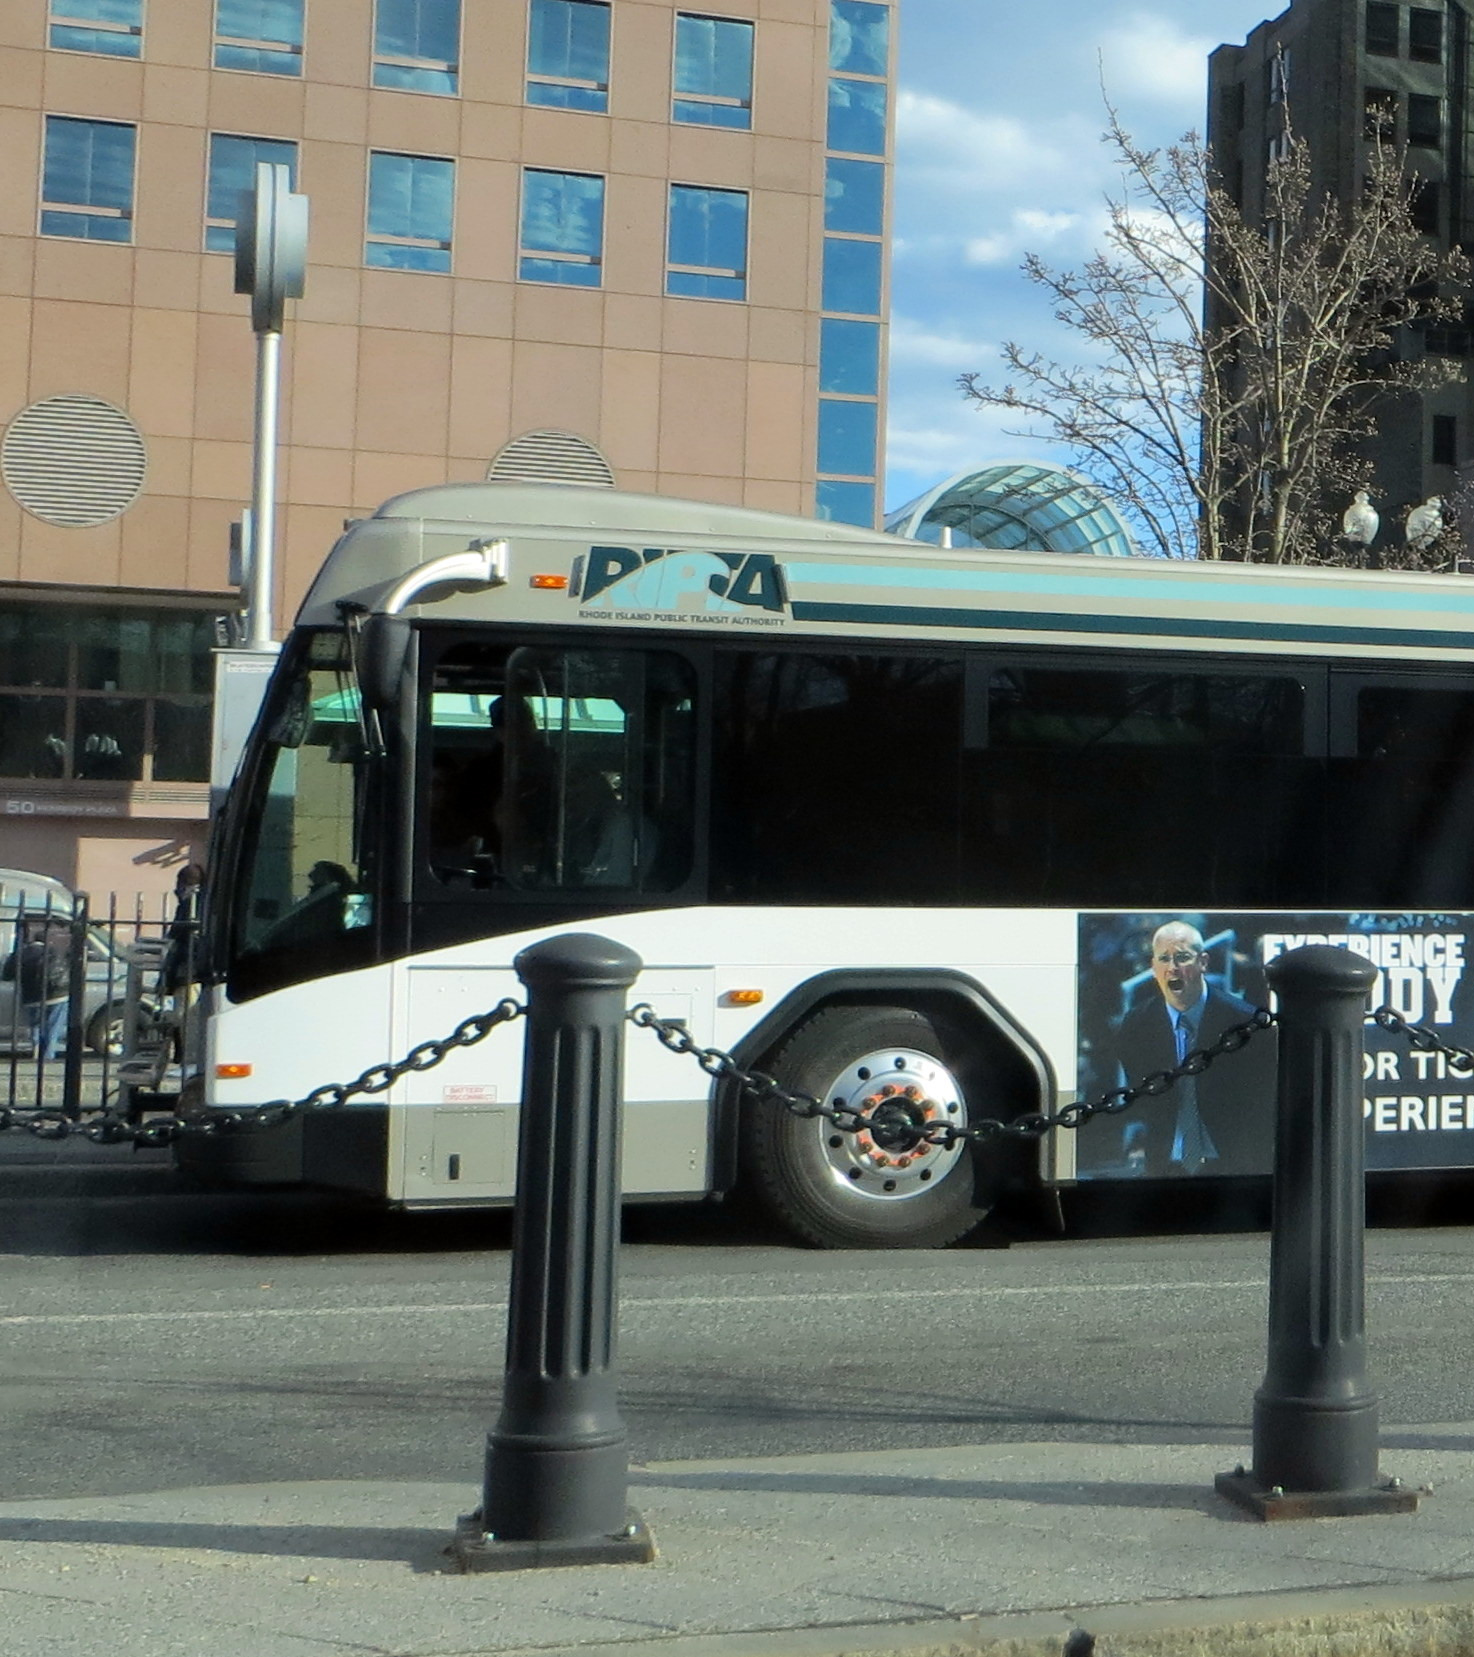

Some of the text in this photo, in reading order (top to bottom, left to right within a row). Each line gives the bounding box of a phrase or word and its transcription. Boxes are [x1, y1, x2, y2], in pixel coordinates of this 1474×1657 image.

[578, 610, 785, 627] RHODE ISLAND PUBLIC TRANSIT AUTHORITY
